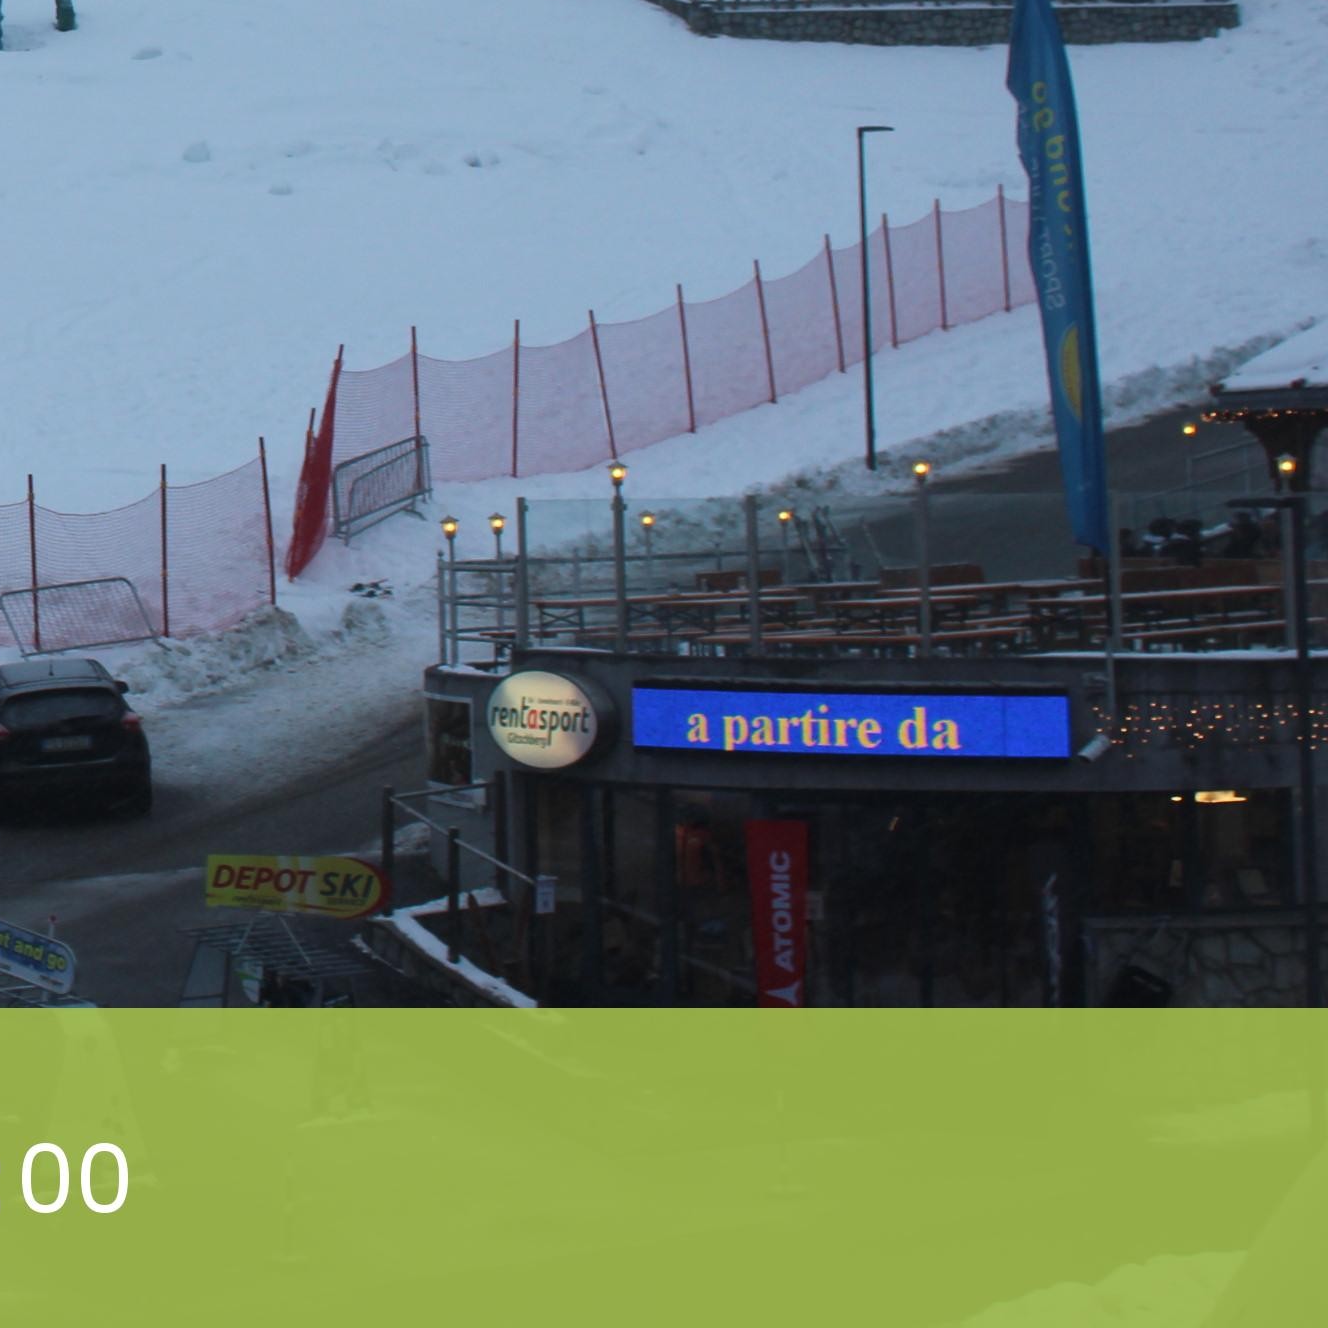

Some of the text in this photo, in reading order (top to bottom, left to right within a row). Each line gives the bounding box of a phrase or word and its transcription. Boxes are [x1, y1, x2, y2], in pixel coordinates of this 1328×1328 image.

[490, 696, 591, 747] rentasport
[687, 704, 963, 751] a partire da
[212, 864, 374, 899] DEPOT SKI
[768, 849, 795, 973] ATOMIC
[14, 940, 44, 962] and
[47, 953, 67, 971] go
